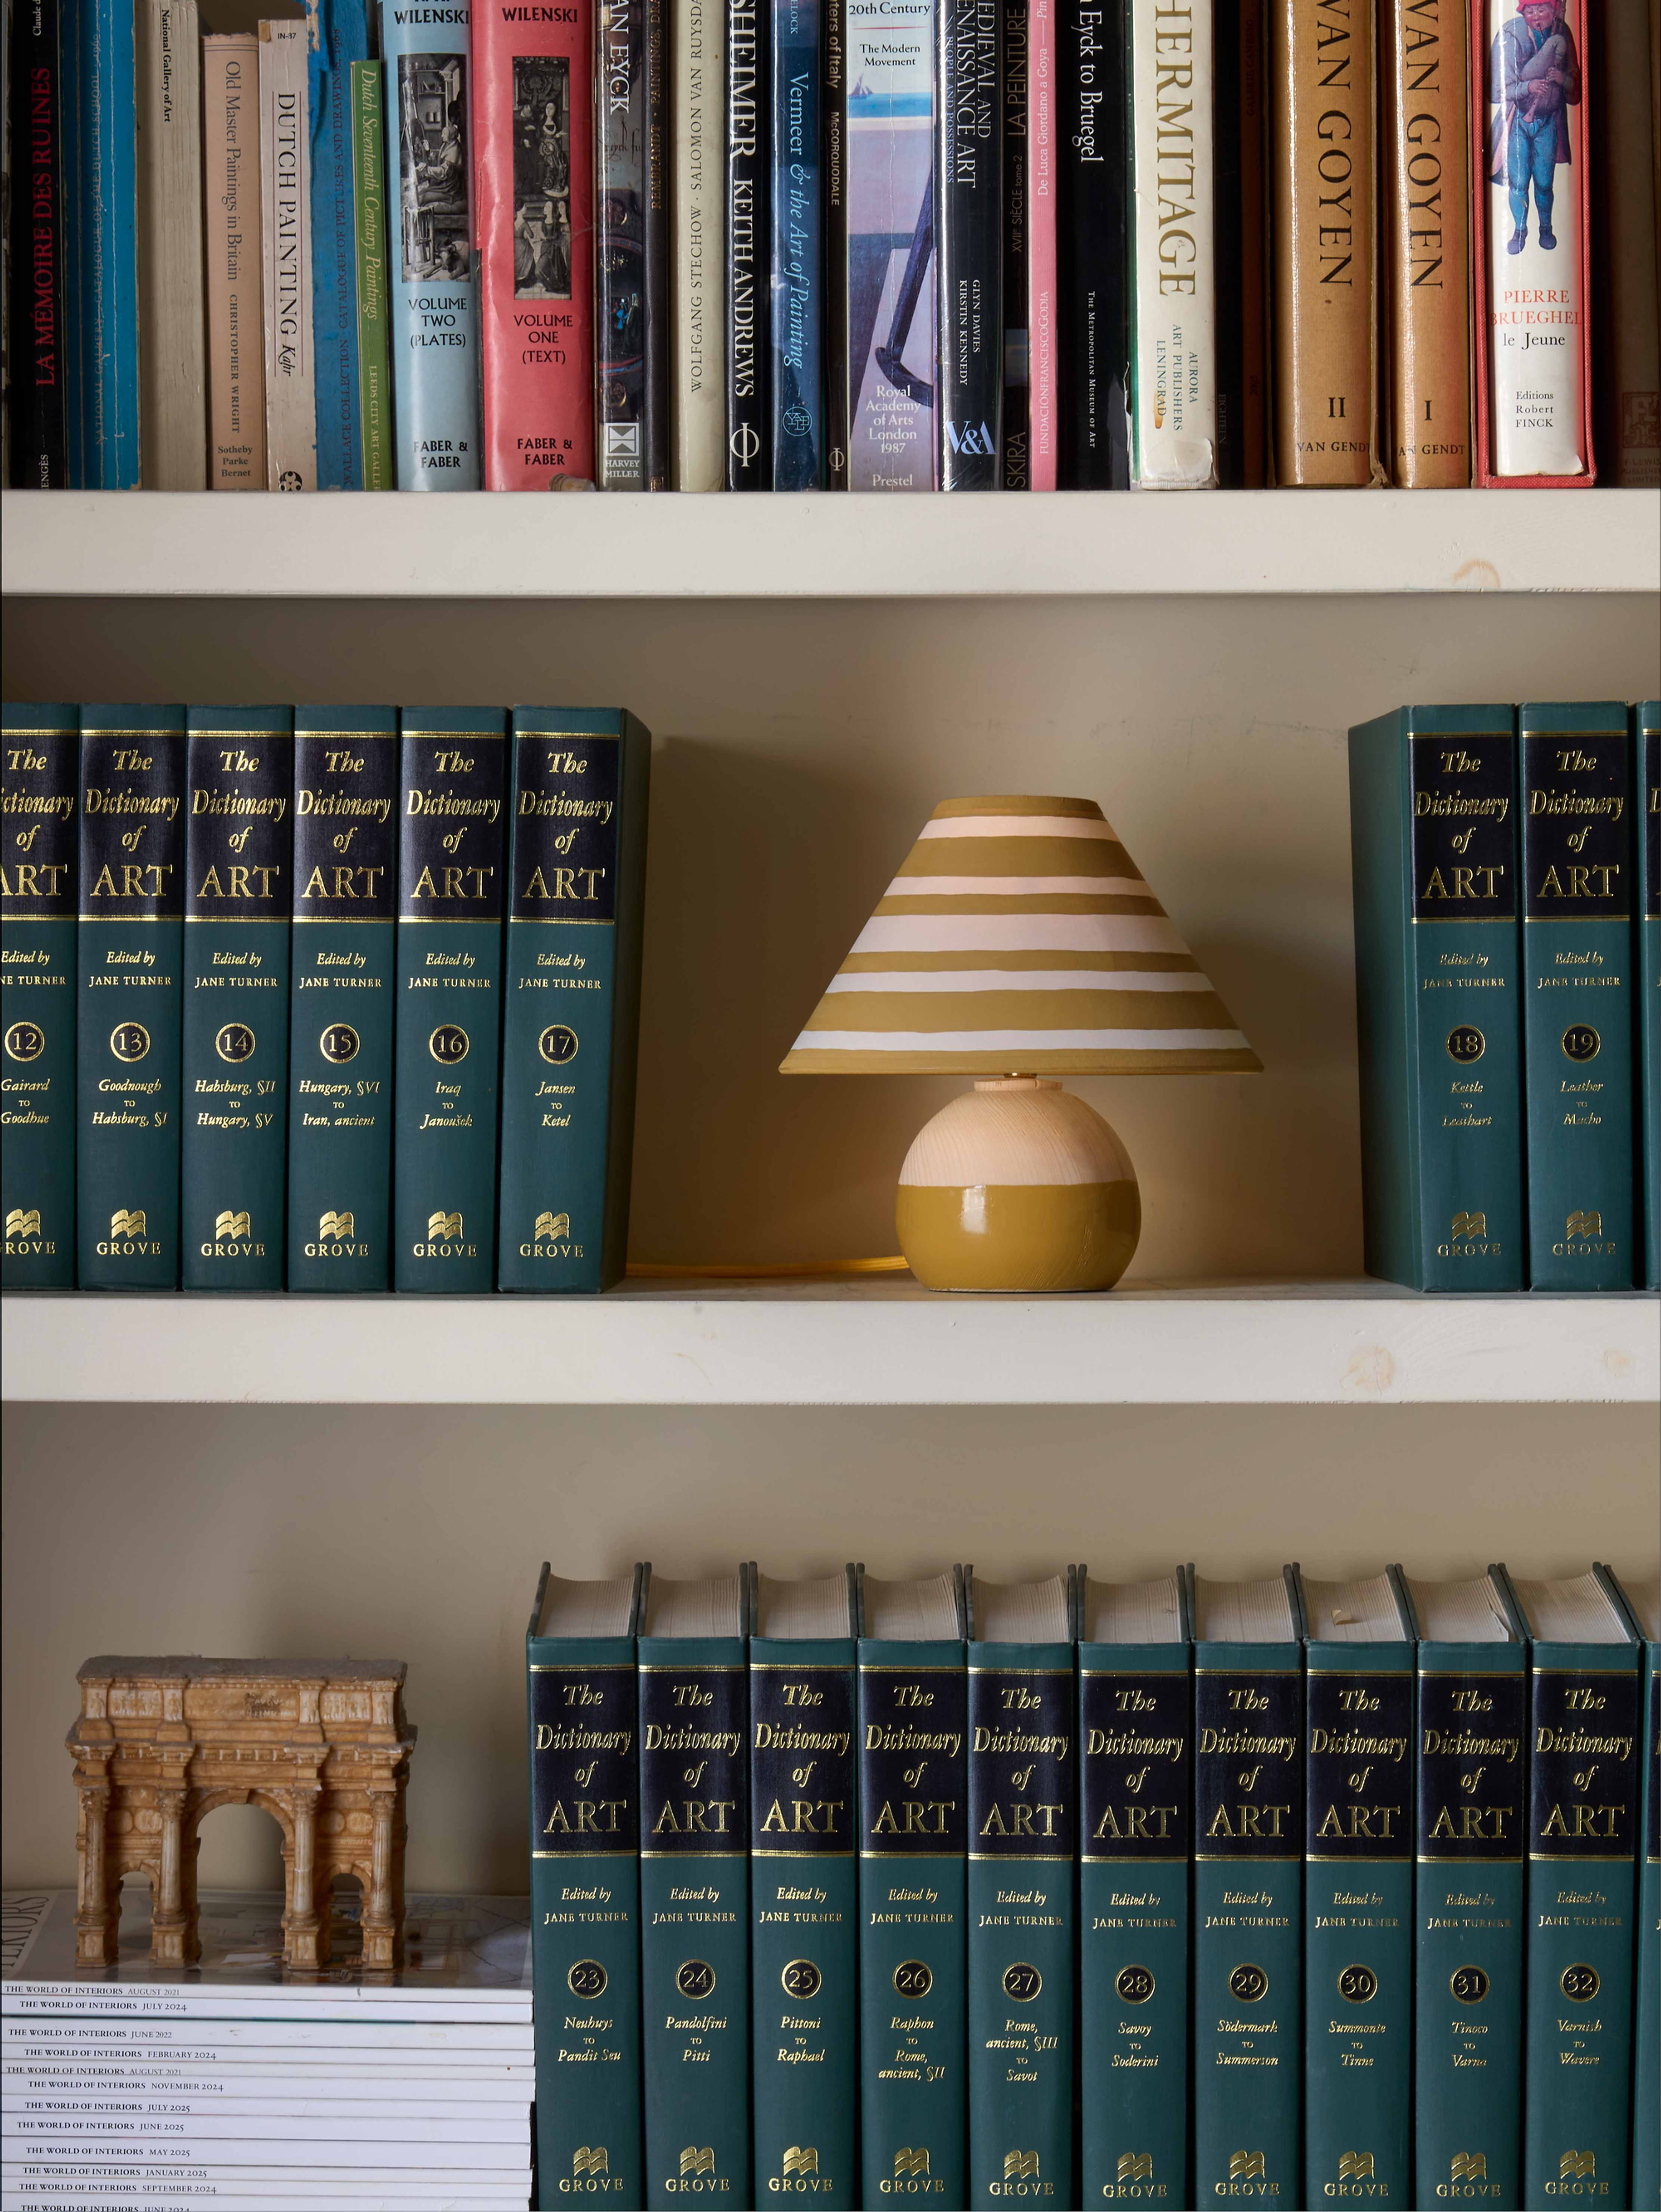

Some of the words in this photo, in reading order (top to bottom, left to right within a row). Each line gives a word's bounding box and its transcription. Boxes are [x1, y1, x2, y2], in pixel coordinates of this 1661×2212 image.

[394, 9, 469, 24] WILENSKI
[502, 7, 578, 23] WILENSKI
[849, 5, 877, 15] 20th
[880, 2, 930, 16] Century
[33, 7, 41, 36] Claude
[163, 10, 171, 52] National
[1071, 10, 1104, 56] Eyck
[829, 36, 840, 51] of
[860, 44, 879, 53] The
[881, 44, 920, 53] Modern
[865, 58, 915, 66] Movement
[1008, 8, 1026, 104] PEINTURE
[1037, 48, 1050, 77] Goya
[162, 54, 171, 92] Gallery
[225, 61, 241, 90] Old
[610, 44, 629, 115] EYCK
[826, 55, 841, 89] Italy
[1080, 64, 1100, 84] to
[361, 69, 377, 109] Dutch
[690, 68, 702, 101] VAN
[164, 93, 172, 106] of
[31, 67, 51, 165] RUINES
[164, 106, 172, 123] Art
[226, 95, 241, 144] Master
[790, 72, 808, 155] Vermeer
[978, 100, 991, 138] AND
[1008, 112, 1025, 136] LA
[1037, 91, 1048, 145] Giordano
[1072, 91, 1104, 163] Bruegel
[278, 93, 296, 188] DUTCH
[334, 134, 342, 161] AND
[690, 108, 702, 190] SALOMON
[362, 116, 378, 192] Seventeenth
[957, 143, 976, 189] ART
[1037, 149, 1048, 177] Luca
[651, 124, 661, 210] REMBRANDT
[790, 163, 810, 184] &
[220, 148, 242, 212] Paintings
[1037, 180, 1048, 196] De
[33, 173, 52, 219] DES
[334, 165, 345, 227] PICTURES
[791, 191, 810, 218] the
[1011, 190, 1022, 224] SIÈCLE
[1318, 110, 1352, 286] GOYEN
[1407, 114, 1442, 288] GOYEN
[228, 216, 242, 230] in
[361, 197, 379, 250] Century
[734, 178, 753, 262] KEITH
[337, 231, 345, 247] OF
[690, 206, 702, 288] STECHOW
[790, 222, 809, 257] Art
[227, 234, 243, 280] Britain
[278, 200, 298, 336] PAINTING
[784, 262, 809, 285] of
[31, 227, 54, 345] MÉMOIRE
[337, 251, 348, 329] CATALOGUE
[362, 256, 381, 321] Paintings
[972, 280, 980, 310] GLYN
[1504, 290, 1569, 304] PIERRE
[408, 298, 467, 310] VOLUME
[421, 315, 455, 326] TWO
[514, 315, 573, 327] VOLUME
[784, 285, 808, 369] Painting
[1490, 311, 1582, 326] BRUEGHEL
[230, 294, 238, 380] CHRISTOPHER
[411, 334, 466, 348] (PLATES)
[528, 332, 559, 343] ONE
[691, 297, 702, 392] WOLFGANG
[734, 268, 754, 397] ANDREWS
[1173, 324, 1182, 348] ART
[1503, 333, 1515, 346] le
[1521, 332, 1565, 350] Jeune
[36, 354, 54, 386] LA
[278, 344, 296, 376] Kahr
[522, 351, 566, 365] (TEXT)
[340, 339, 351, 420] COLLECTION
[370, 366, 378, 396] LEEDS
[1157, 340, 1166, 416] LENINGRAD
[1189, 352, 1198, 403] AURORA
[877, 385, 910, 398] Royal
[1173, 355, 1182, 431] PUBLISHERS
[1516, 391, 1554, 400] Editions
[231, 386, 240, 433] WRIGHT
[371, 399, 379, 426] CITY
[866, 400, 920, 413] Academy
[1328, 398, 1345, 418] II
[1424, 401, 1432, 420] I
[1516, 405, 1554, 414] Robert
[874, 414, 885, 425] of
[889, 417, 913, 426] Arts
[1515, 419, 1553, 428] FINCK
[371, 428, 379, 452] ART
[414, 441, 452, 453] FABER
[459, 441, 468, 452] &
[518, 438, 556, 450] FABER
[563, 439, 572, 449] &
[869, 429, 917, 441] London
[945, 421, 996, 454] V&A
[218, 446, 253, 456] Sotheby
[342, 424, 352, 485] WALLACE
[525, 453, 565, 465] FABER
[881, 443, 906, 453] 1987
[1008, 432, 1026, 487] SKIRA
[1297, 443, 1325, 452] VAN
[1422, 444, 1464, 454] GENDT
[221, 469, 251, 478] Bernet
[222, 457, 248, 466] Parke
[421, 457, 460, 469] FABER
[872, 475, 913, 487] Prestel
[119, 1033, 142, 1050] 13
[330, 1036, 352, 1052] 15
[99, 1079, 161, 1094] Goodnough
[299, 1081, 353, 1095] Hungary,
[93, 1112, 149, 1127] Habsburg,
[303, 1114, 331, 1128] Iran,
[335, 1115, 375, 1126] ancient
[97, 1242, 160, 1255] GROVE
[673, 1685, 713, 1706] The
[645, 1725, 740, 1756] Dictionary
[684, 1761, 708, 1788] of
[652, 1800, 735, 1833] ART
[670, 1887, 705, 1900] Edited
[708, 1887, 720, 1902] by
[653, 1913, 683, 1924] JANE
[687, 1913, 736, 1922] TURNER
[683, 1968, 709, 1988] 24
[142, 2003, 163, 2011] JULY
[165, 2004, 187, 2012] 2024
[665, 2016, 727, 2029] Pandolfini
[683, 2049, 710, 2062] Pitti
[665, 2179, 729, 2192] GROVE
